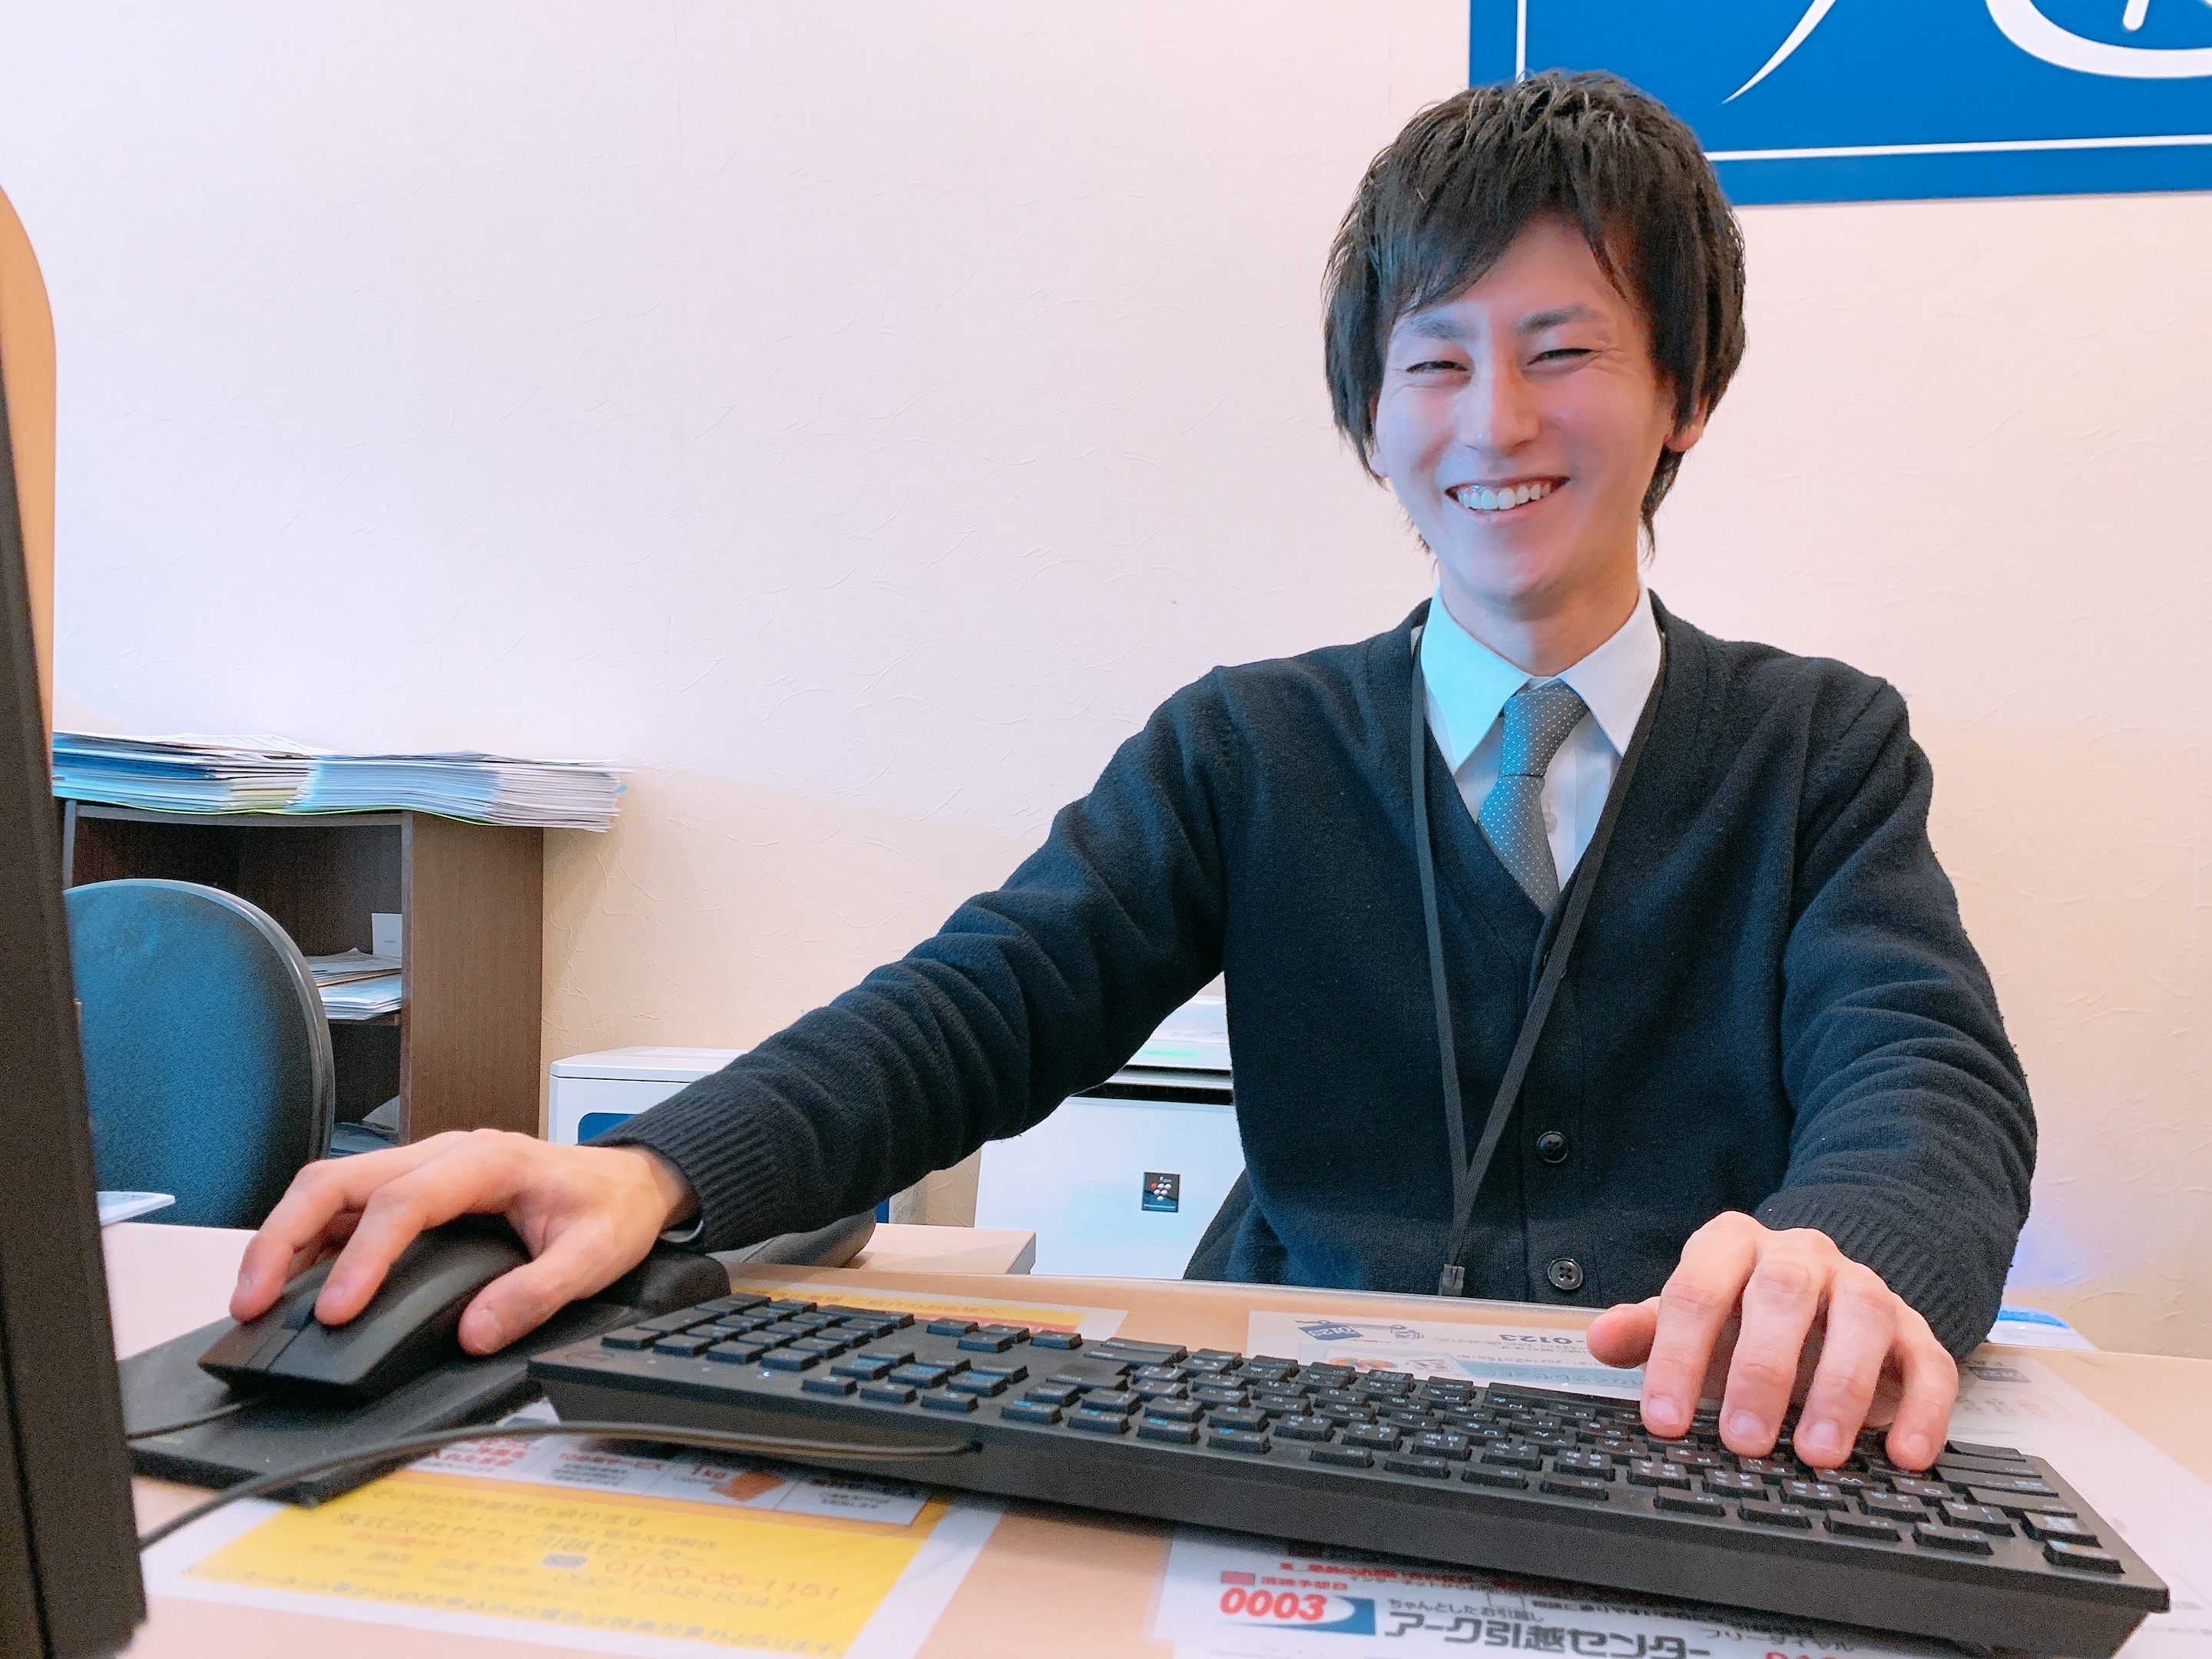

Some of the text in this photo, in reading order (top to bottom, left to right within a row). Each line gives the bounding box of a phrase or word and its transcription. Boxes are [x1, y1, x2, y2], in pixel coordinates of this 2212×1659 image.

[1220, 1587, 1328, 1621] 0003
[1383, 1611, 1710, 1659] アーク引越センター
